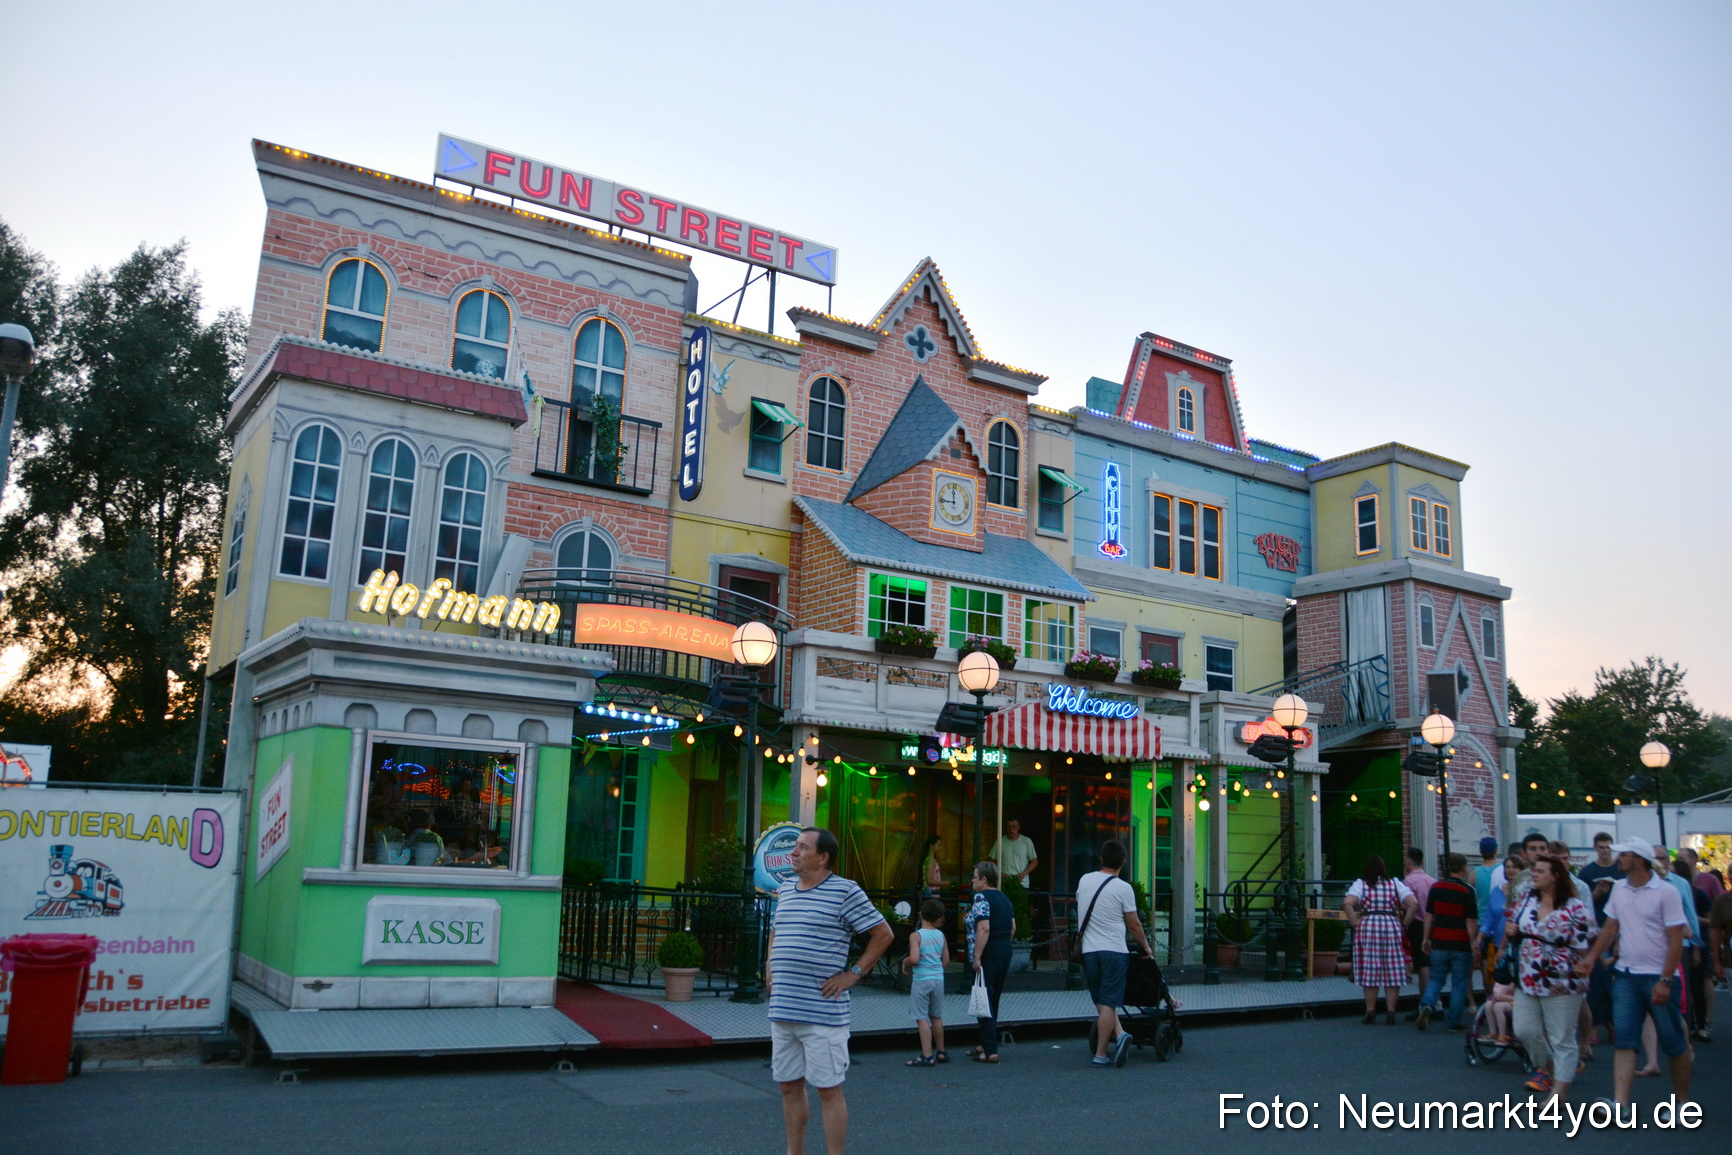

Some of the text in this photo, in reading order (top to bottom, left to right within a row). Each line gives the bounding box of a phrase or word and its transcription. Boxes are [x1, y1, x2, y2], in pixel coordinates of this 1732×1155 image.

[483, 149, 804, 271] FUN STREET
[682, 337, 703, 489] HOTEL
[1106, 475, 1118, 540] CITY
[1104, 543, 1122, 556] BAR
[356, 568, 561, 635] Hofmann
[580, 616, 730, 651] SPASS-ARENA
[1048, 682, 1139, 719] Welcome
[266, 786, 282, 821] FUN
[260, 810, 288, 859] STREET
[766, 853, 793, 869] FUN-S
[96, 935, 195, 955] senbahn
[381, 919, 485, 945] KASSE
[78, 995, 211, 1017] sbetriebe
